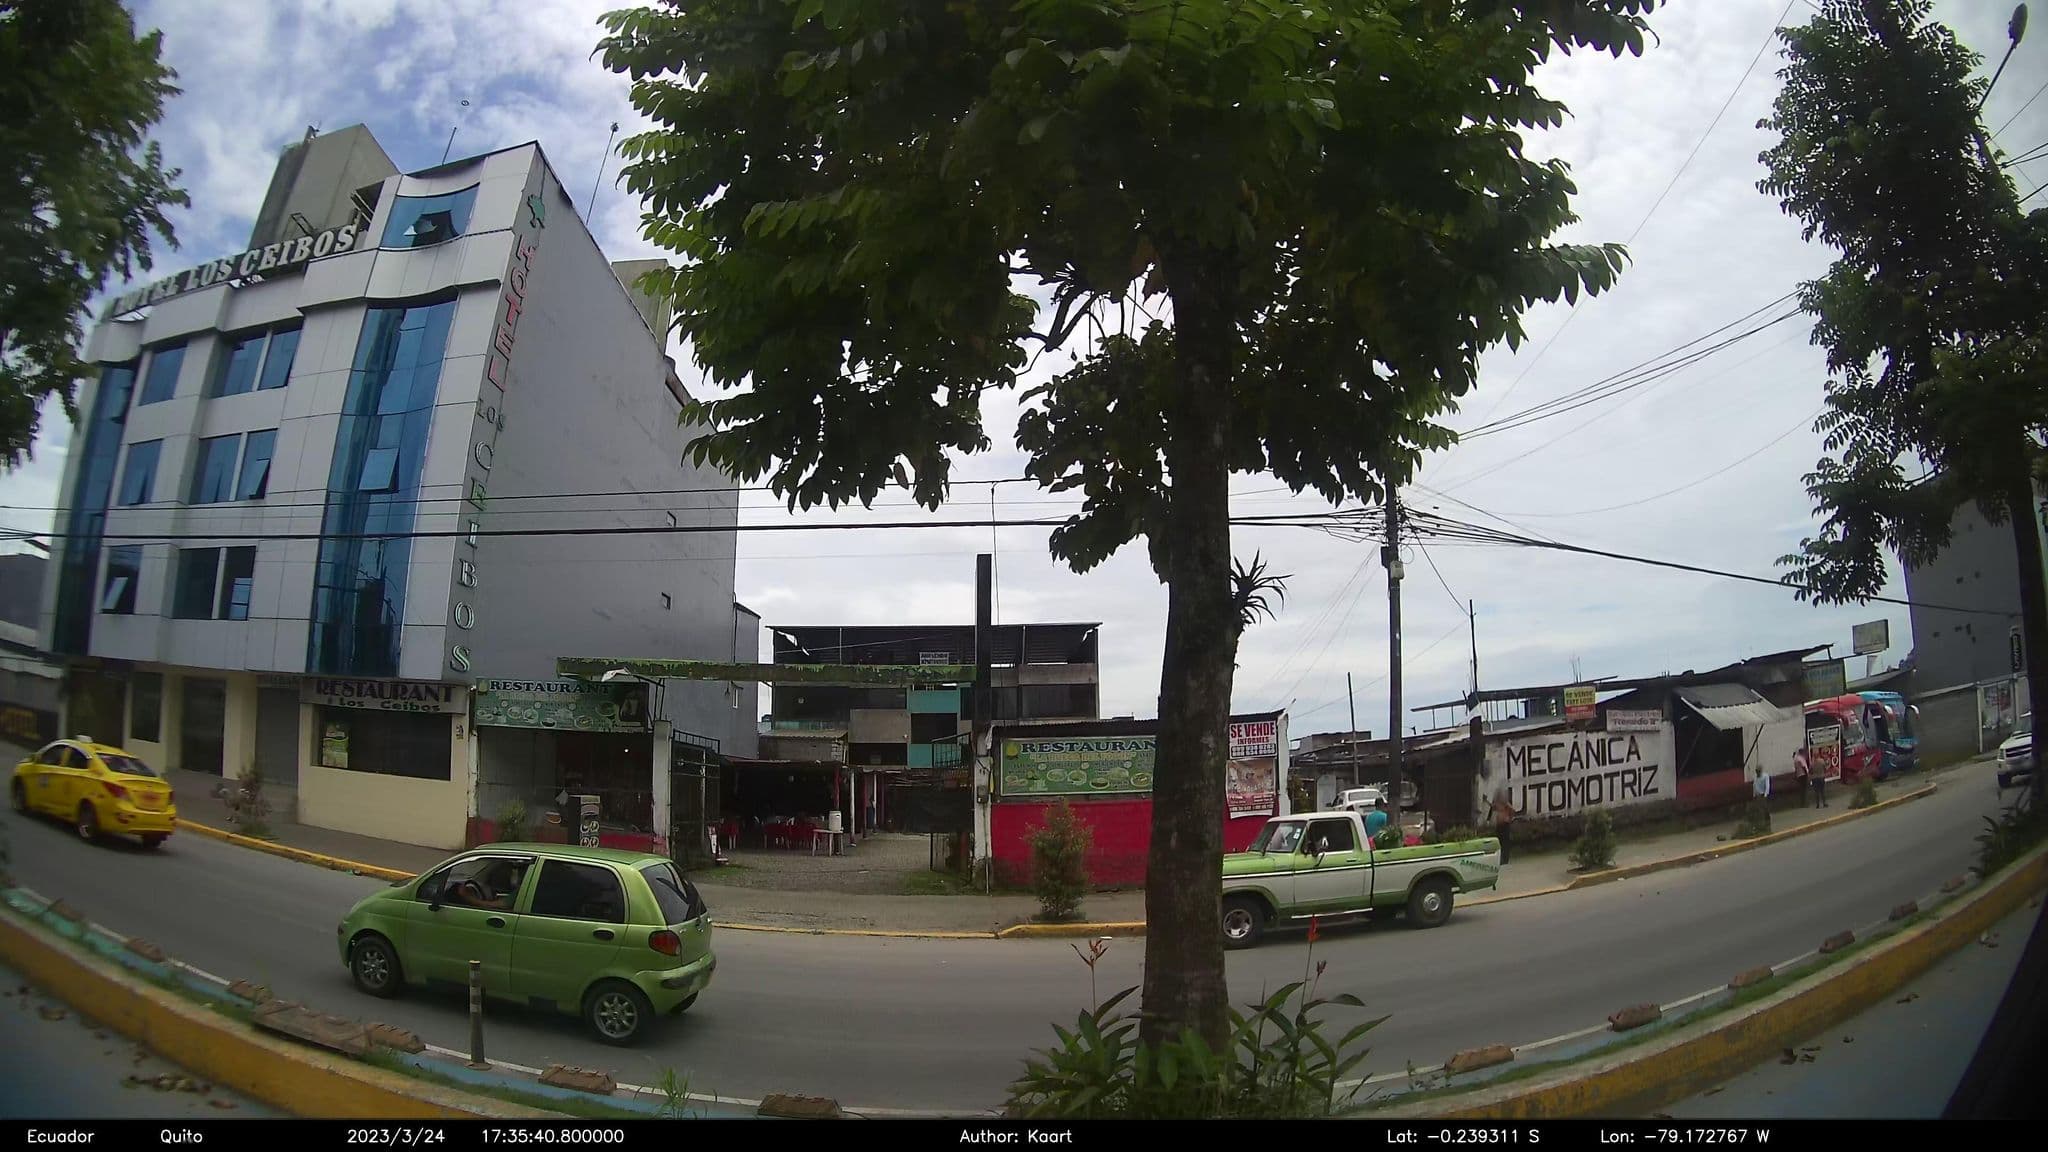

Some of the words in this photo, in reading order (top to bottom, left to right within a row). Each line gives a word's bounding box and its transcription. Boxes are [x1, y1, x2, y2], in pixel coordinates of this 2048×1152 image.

[183, 256, 234, 291] LOS
[240, 223, 358, 277] CEIBOS
[488, 234, 536, 393] HOTEL
[450, 440, 495, 674] CEIBOS
[316, 680, 456, 703] RESTAURANT
[489, 680, 612, 695] RESTAURANT
[380, 700, 441, 712] Ceibos
[1230, 724, 1243, 739] SE
[1244, 721, 1276, 738] VENDE
[1021, 740, 1158, 753] RESTAURAN
[1506, 735, 1641, 779] MECÁNICA
